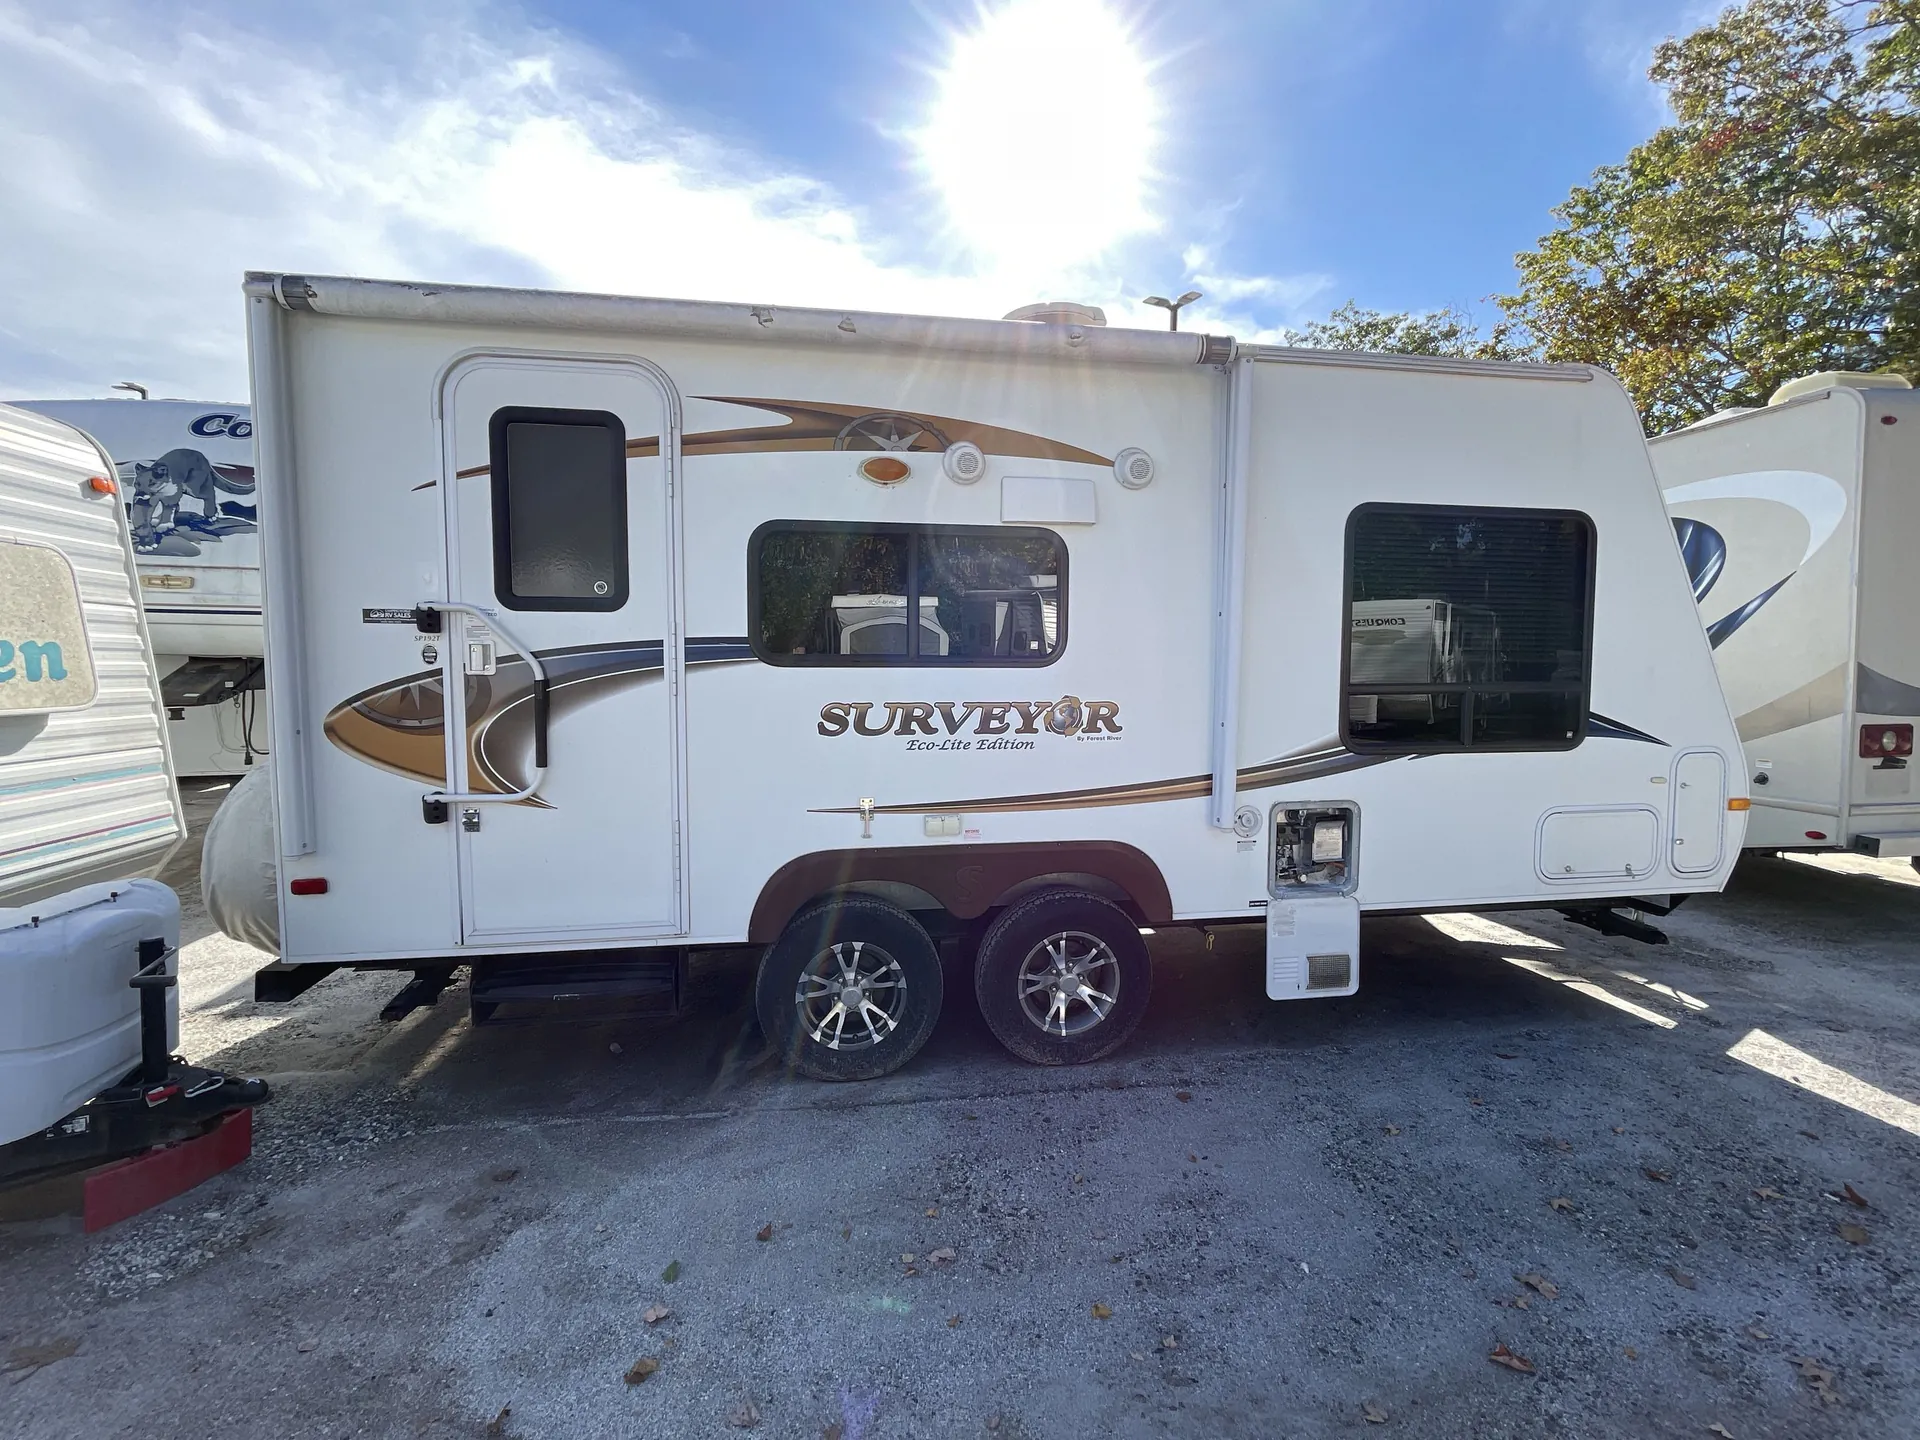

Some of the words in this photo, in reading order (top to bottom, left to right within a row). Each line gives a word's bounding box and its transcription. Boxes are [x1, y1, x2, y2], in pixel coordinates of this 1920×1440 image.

[817, 696, 1123, 737] SURVEYOR
[905, 738, 971, 751] Eco-Lite
[975, 737, 1035, 750] Edition
